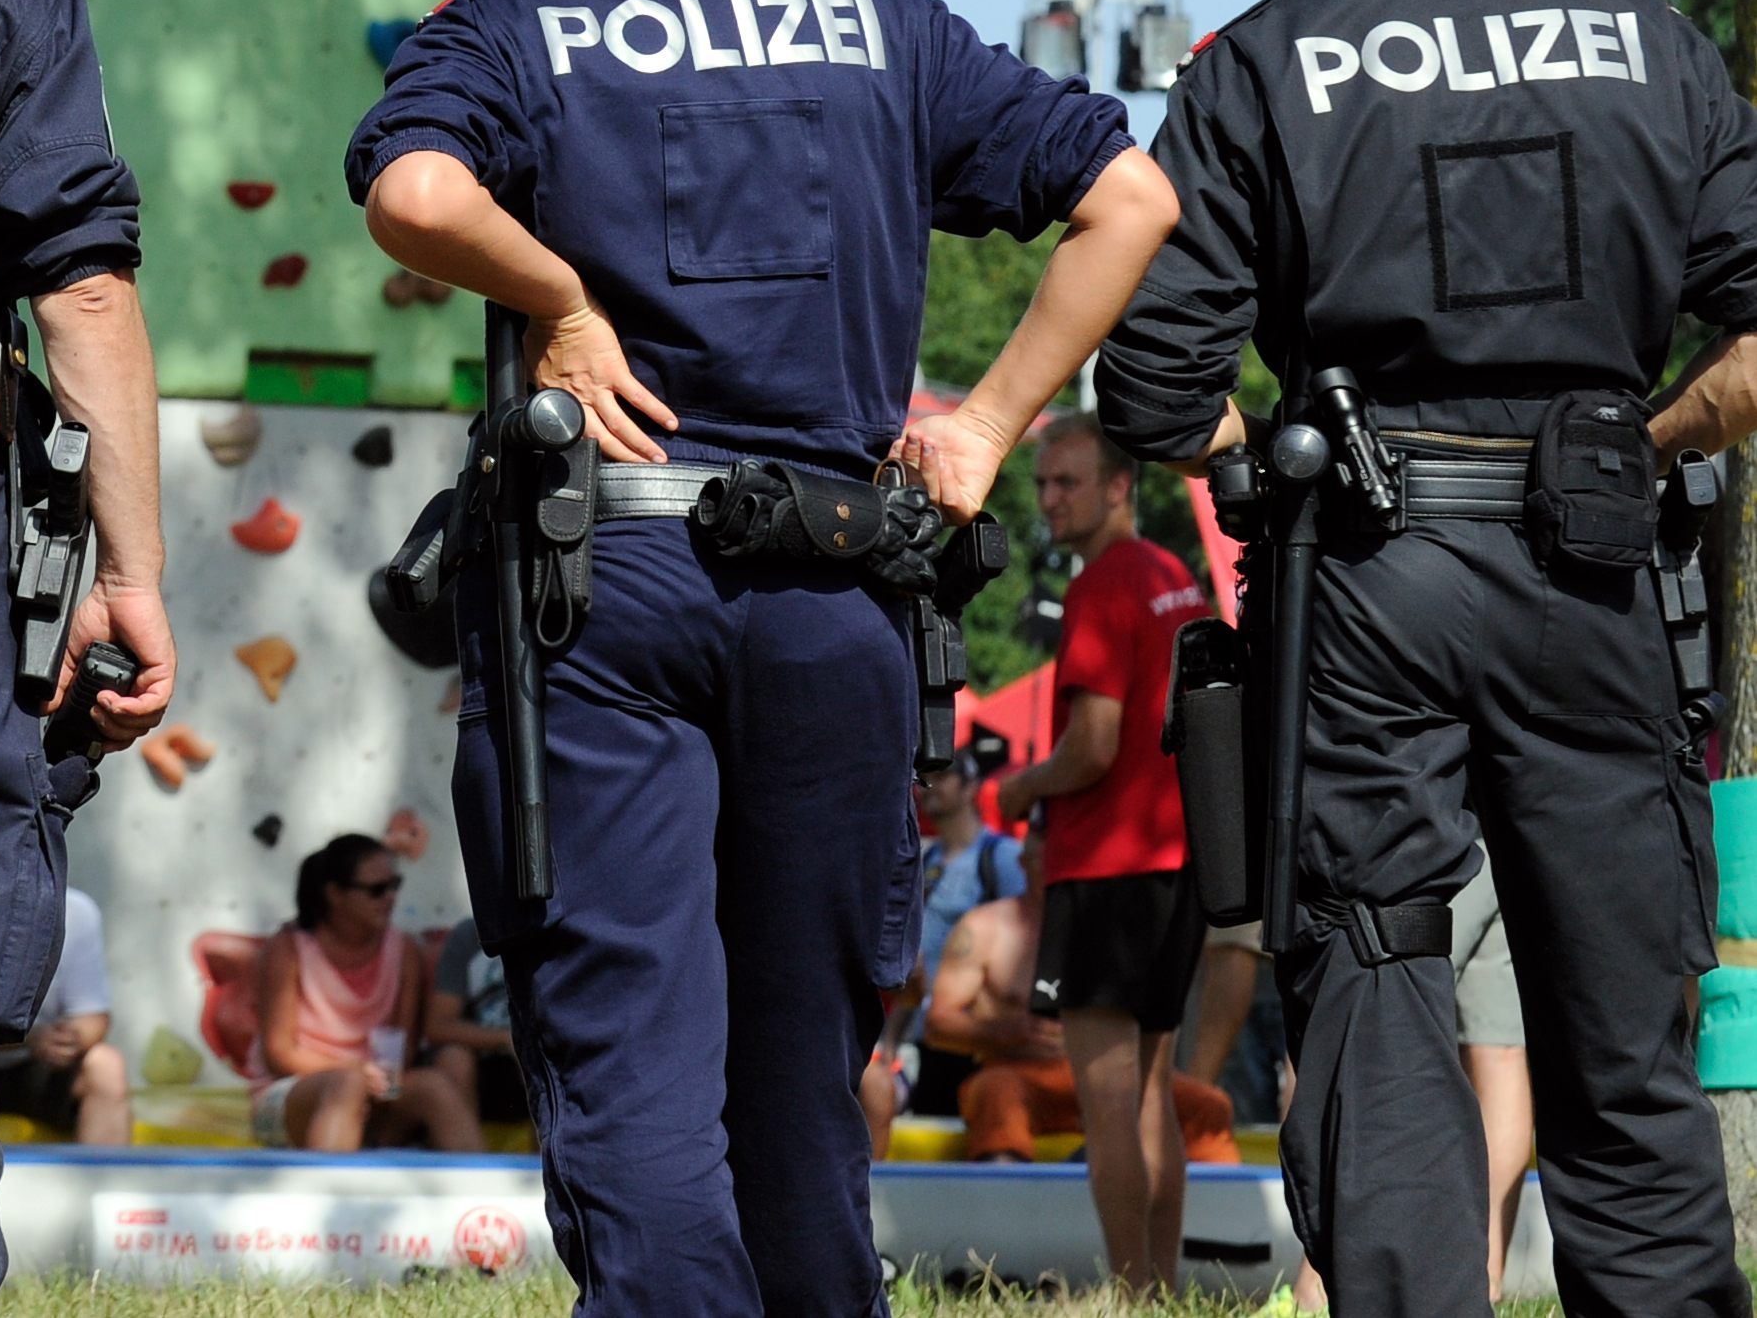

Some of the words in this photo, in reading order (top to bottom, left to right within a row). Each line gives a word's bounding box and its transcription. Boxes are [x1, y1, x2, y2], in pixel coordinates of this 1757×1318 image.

[1294, 7, 1648, 115] POLIZEI
[114, 1233, 198, 1258] Wien
[213, 1230, 363, 1258] bewegen
[377, 1234, 432, 1259] Wir
